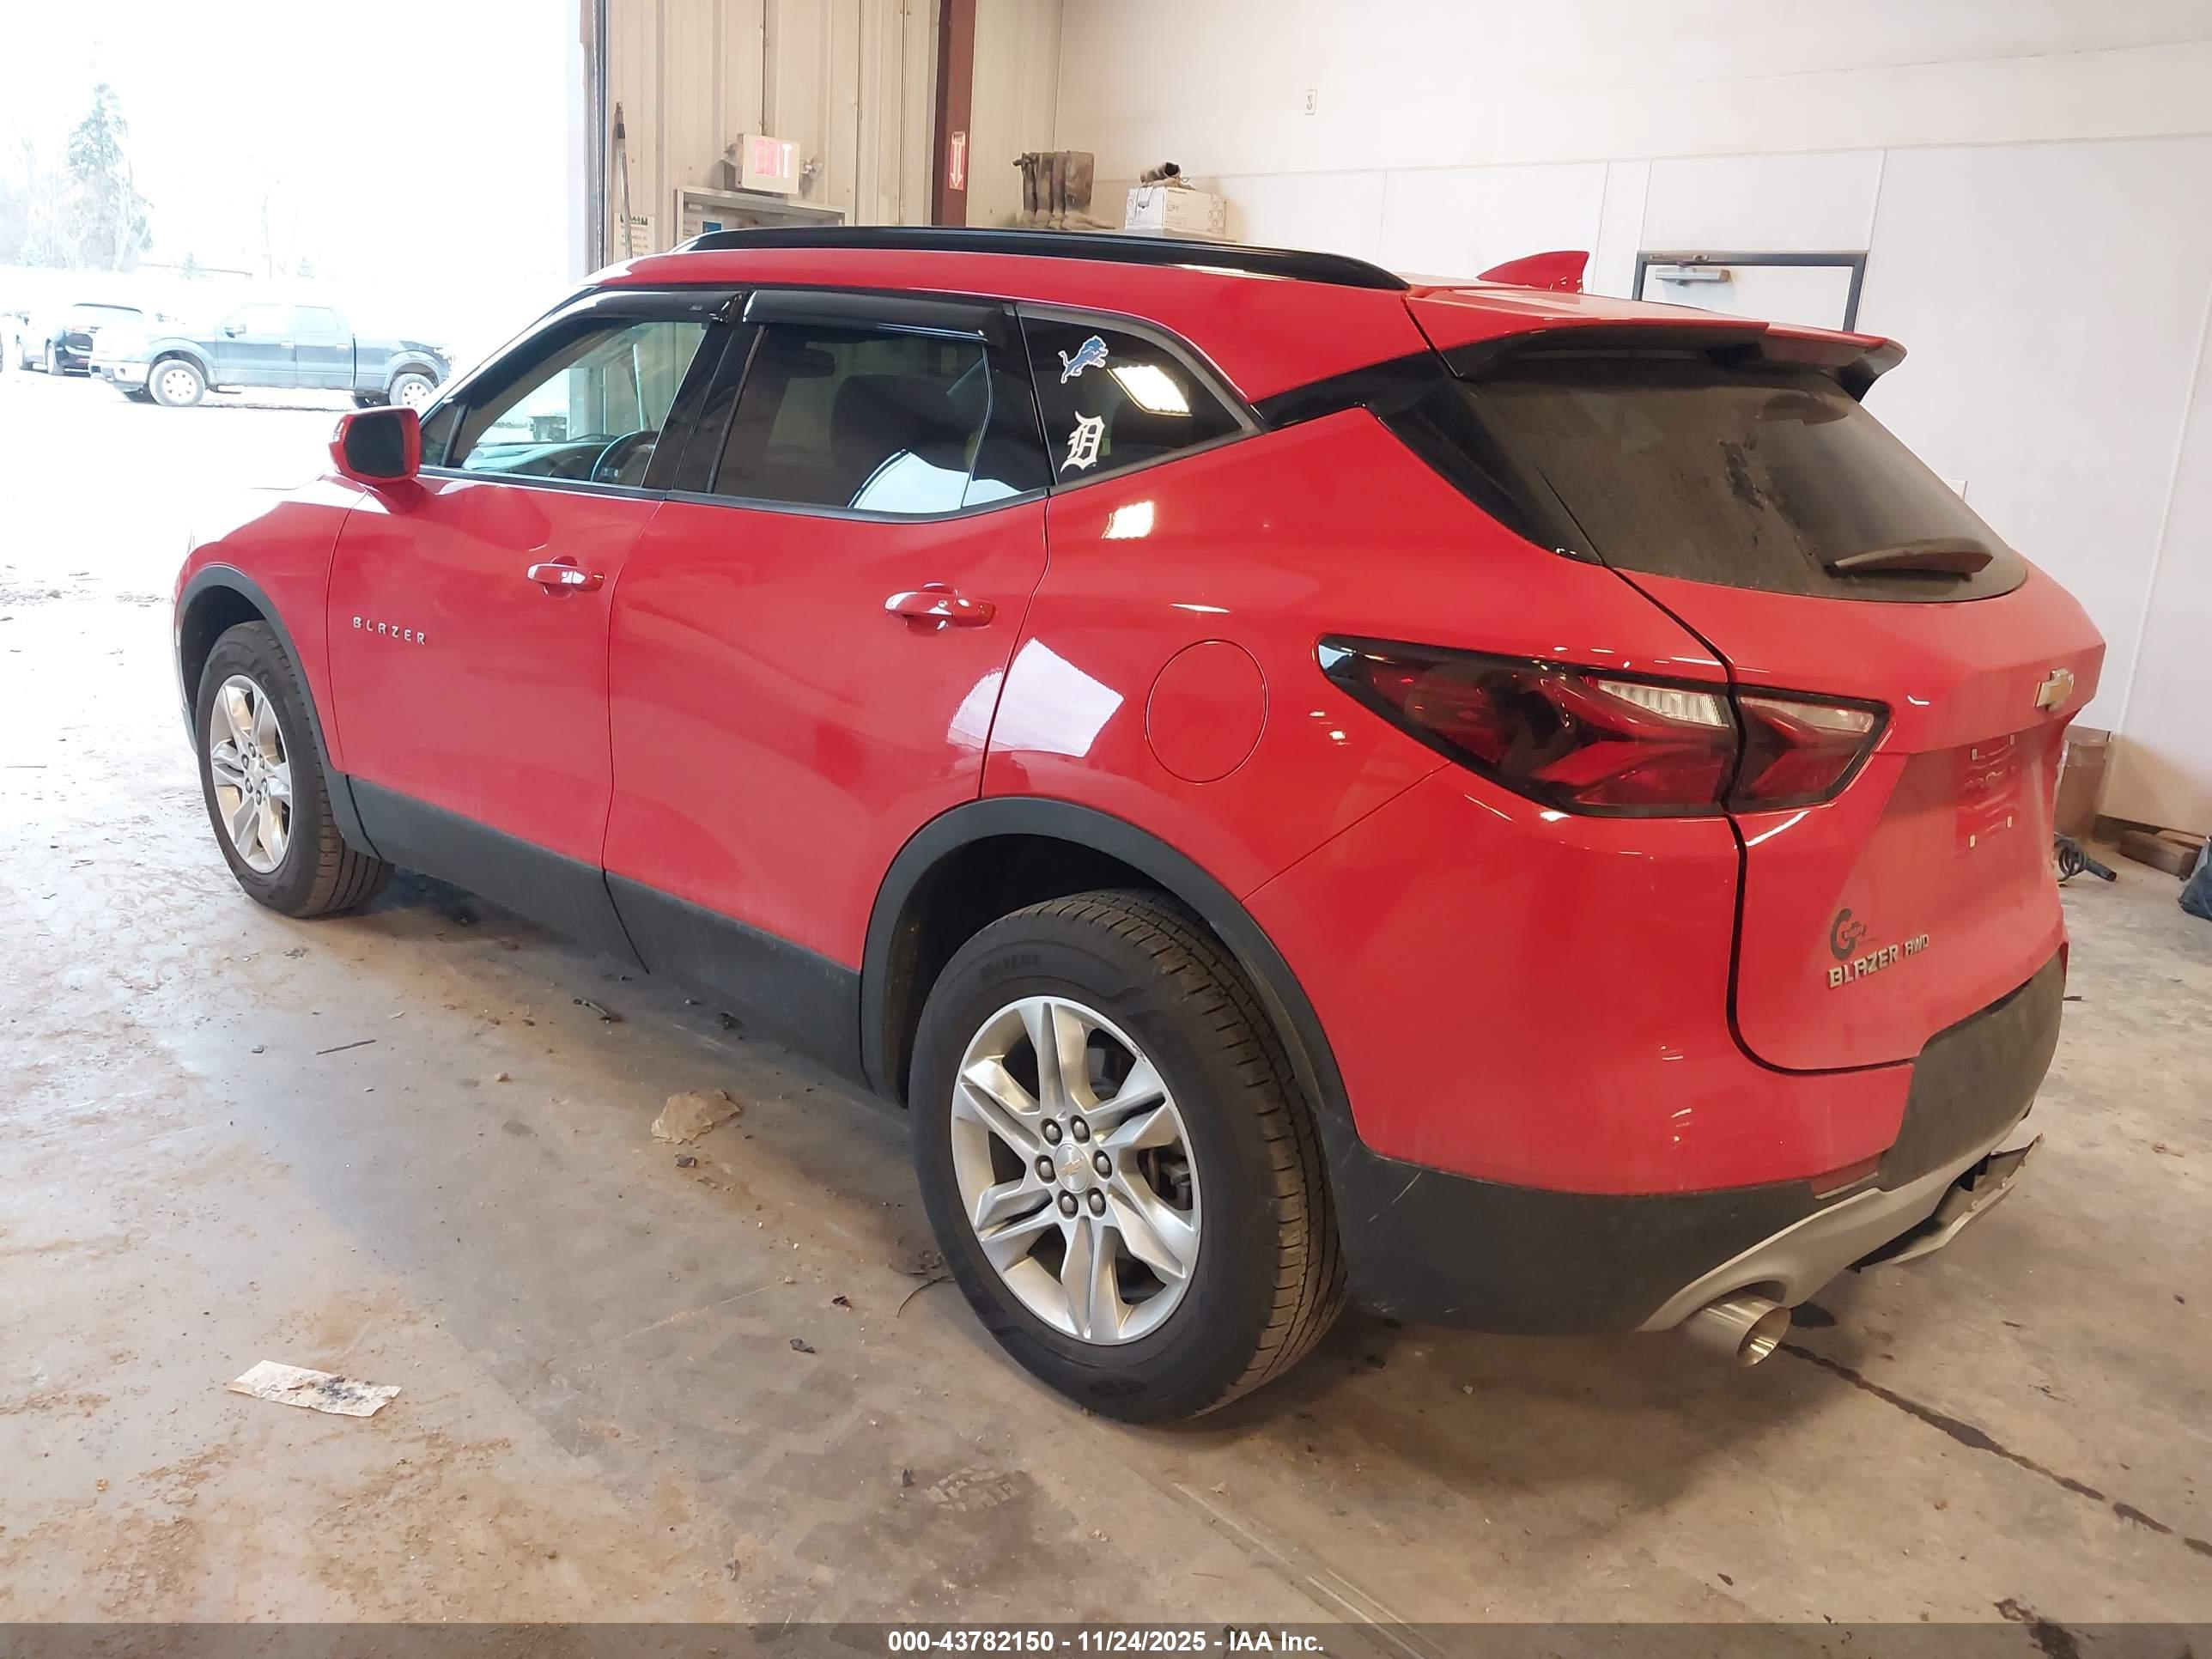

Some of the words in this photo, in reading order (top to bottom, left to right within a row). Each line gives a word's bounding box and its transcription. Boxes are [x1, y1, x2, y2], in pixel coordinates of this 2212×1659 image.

[755, 139, 793, 179] EXIT
[353, 616, 425, 645] BLAZER
[1828, 944, 1899, 988] BLAZER
[1904, 933, 1929, 957] AWD
